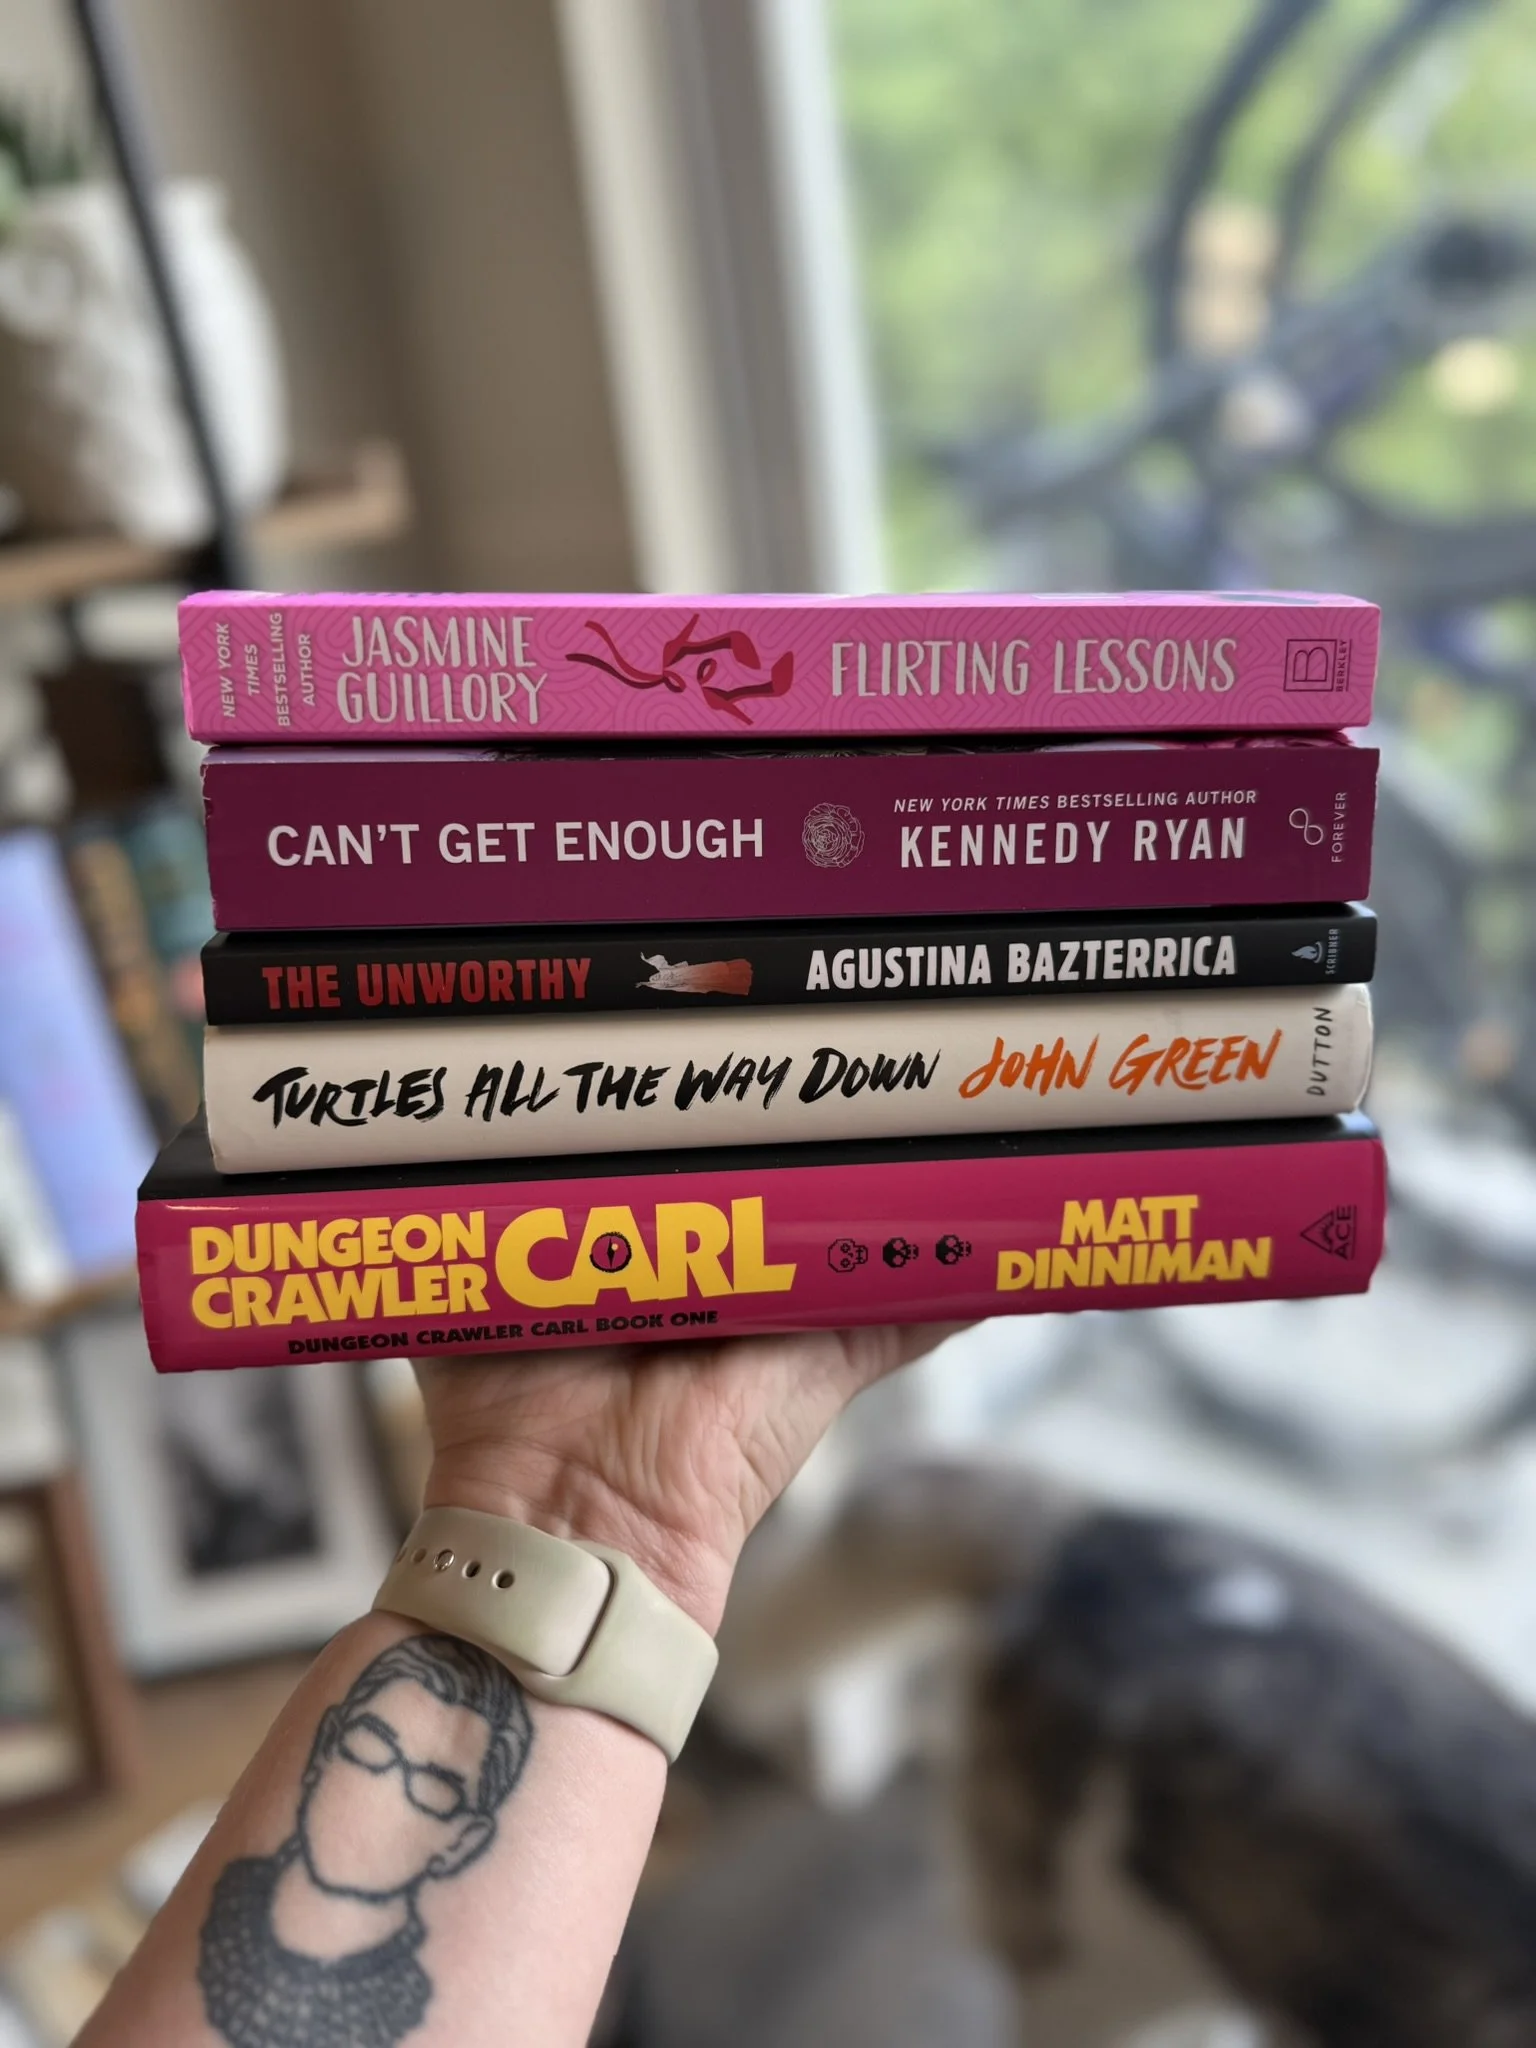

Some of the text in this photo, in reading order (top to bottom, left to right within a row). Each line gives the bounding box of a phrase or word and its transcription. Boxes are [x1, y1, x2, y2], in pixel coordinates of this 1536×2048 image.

[269, 612, 290, 727] BESTSELLING
[342, 615, 536, 668] JASMINE
[832, 638, 1237, 698] FLIRTING LESSONS
[1335, 639, 1348, 692] BERKLEY
[218, 623, 236, 718] NEW YORK
[247, 643, 260, 697] TIMES
[298, 633, 316, 707] AUTHOR
[336, 672, 548, 725] GUILLORY
[894, 789, 1258, 813] NEW YORK TIMES BESTSELLING AUTHOR
[1331, 792, 1347, 863] FOREVER
[267, 819, 764, 867] CAN'T GET ENOUGH
[900, 816, 1246, 868] KENNEDY RYAN
[261, 957, 592, 1010] THE UNWORTHY
[806, 935, 1236, 991] AGUSTINA BAZTERRICA
[958, 1028, 1283, 1098] JOHN GREEN
[1306, 1007, 1332, 1096] DUTTON
[253, 1047, 941, 1128] TURTLES ALL THE WAY DOWN
[190, 1210, 487, 1275] DUNGEON
[1060, 1195, 1199, 1245] MATT
[1334, 1205, 1351, 1261] ACE
[495, 1196, 797, 1308] CARL
[997, 1237, 1272, 1292] DINNIMAN
[191, 1263, 491, 1328] CRAWLER
[288, 1309, 719, 1355] DUNGEON CRAWLER CARL BOOK ONE
